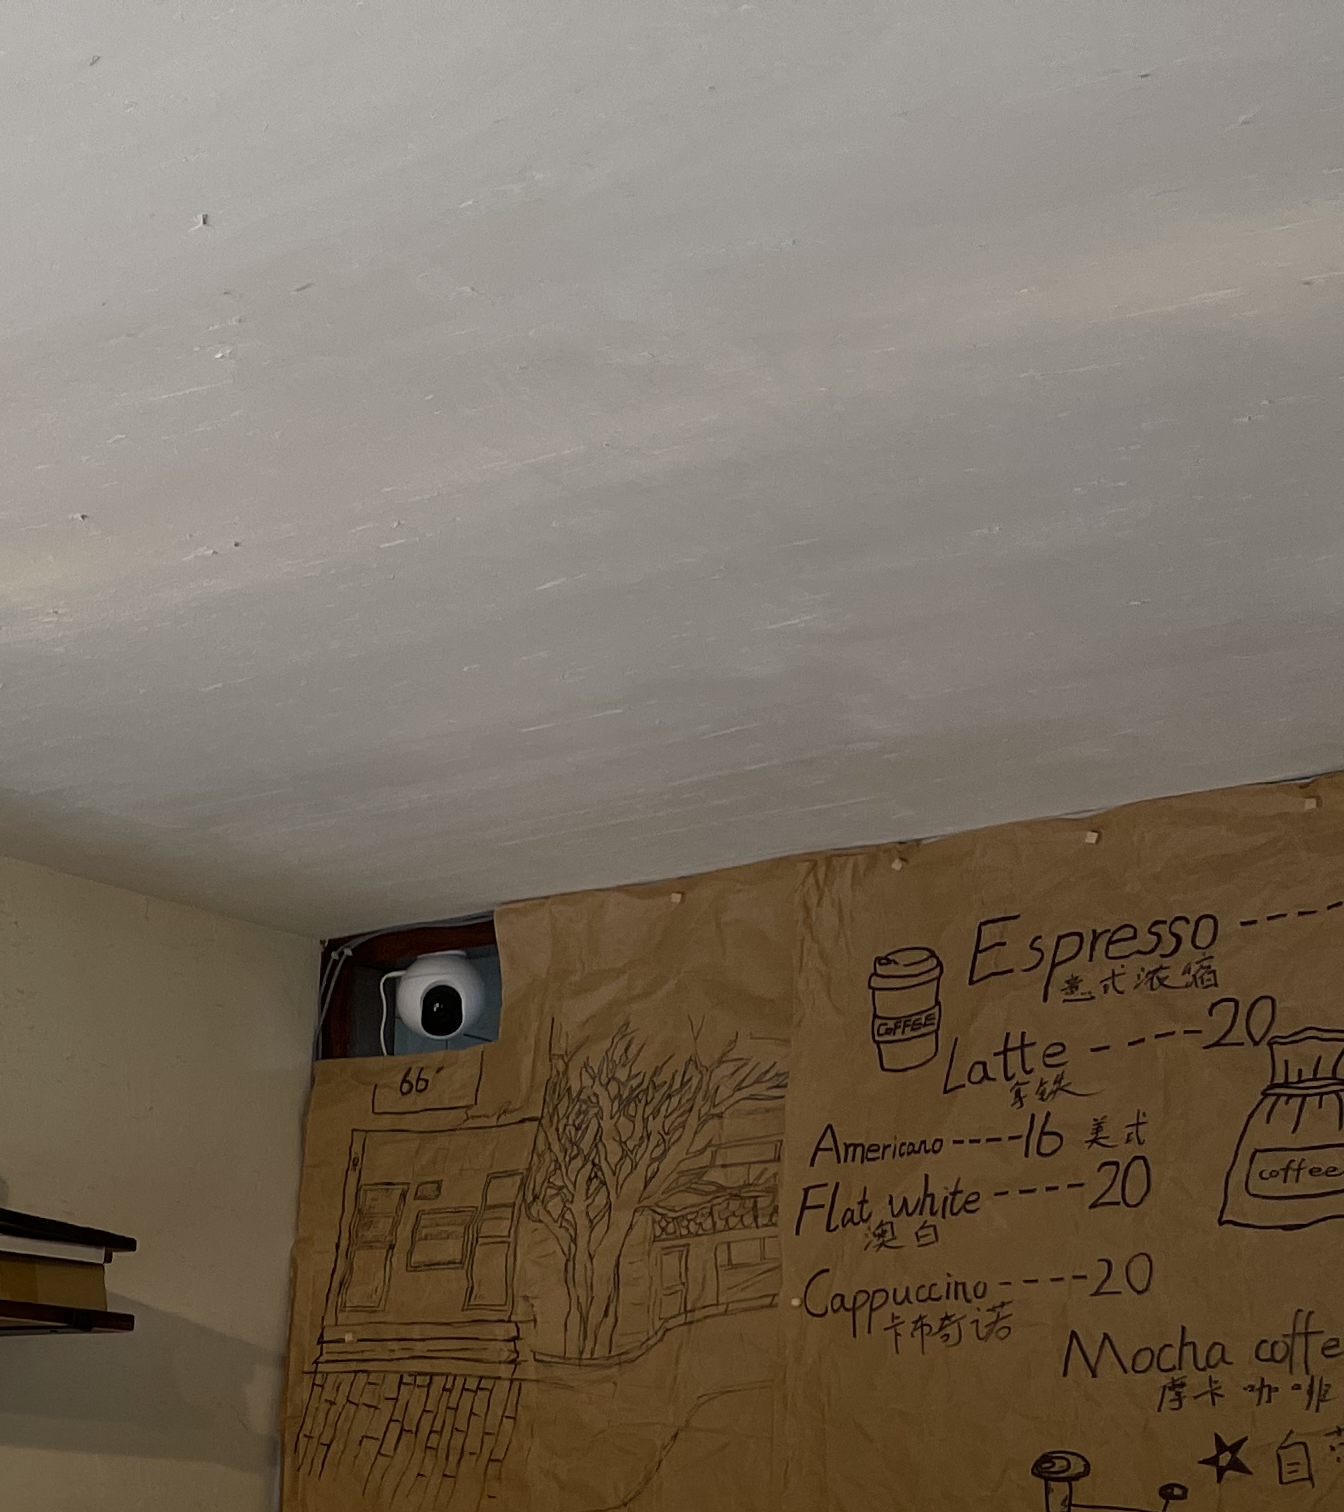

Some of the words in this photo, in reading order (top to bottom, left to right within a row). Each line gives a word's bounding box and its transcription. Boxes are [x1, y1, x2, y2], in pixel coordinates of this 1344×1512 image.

[969, 914, 1220, 1003] Espresso
[943, 1031, 1069, 1095] Latte
[1203, 995, 1277, 1050] 20
[811, 1123, 945, 1168] Americano
[1023, 1112, 1065, 1158] 16
[794, 1180, 872, 1236] Flat
[888, 1174, 981, 1222] white
[1088, 1156, 1152, 1210] 20
[803, 1269, 988, 1338] Cappuccino
[1089, 1252, 1154, 1297] 20
[1062, 1325, 1234, 1378] Mocha
